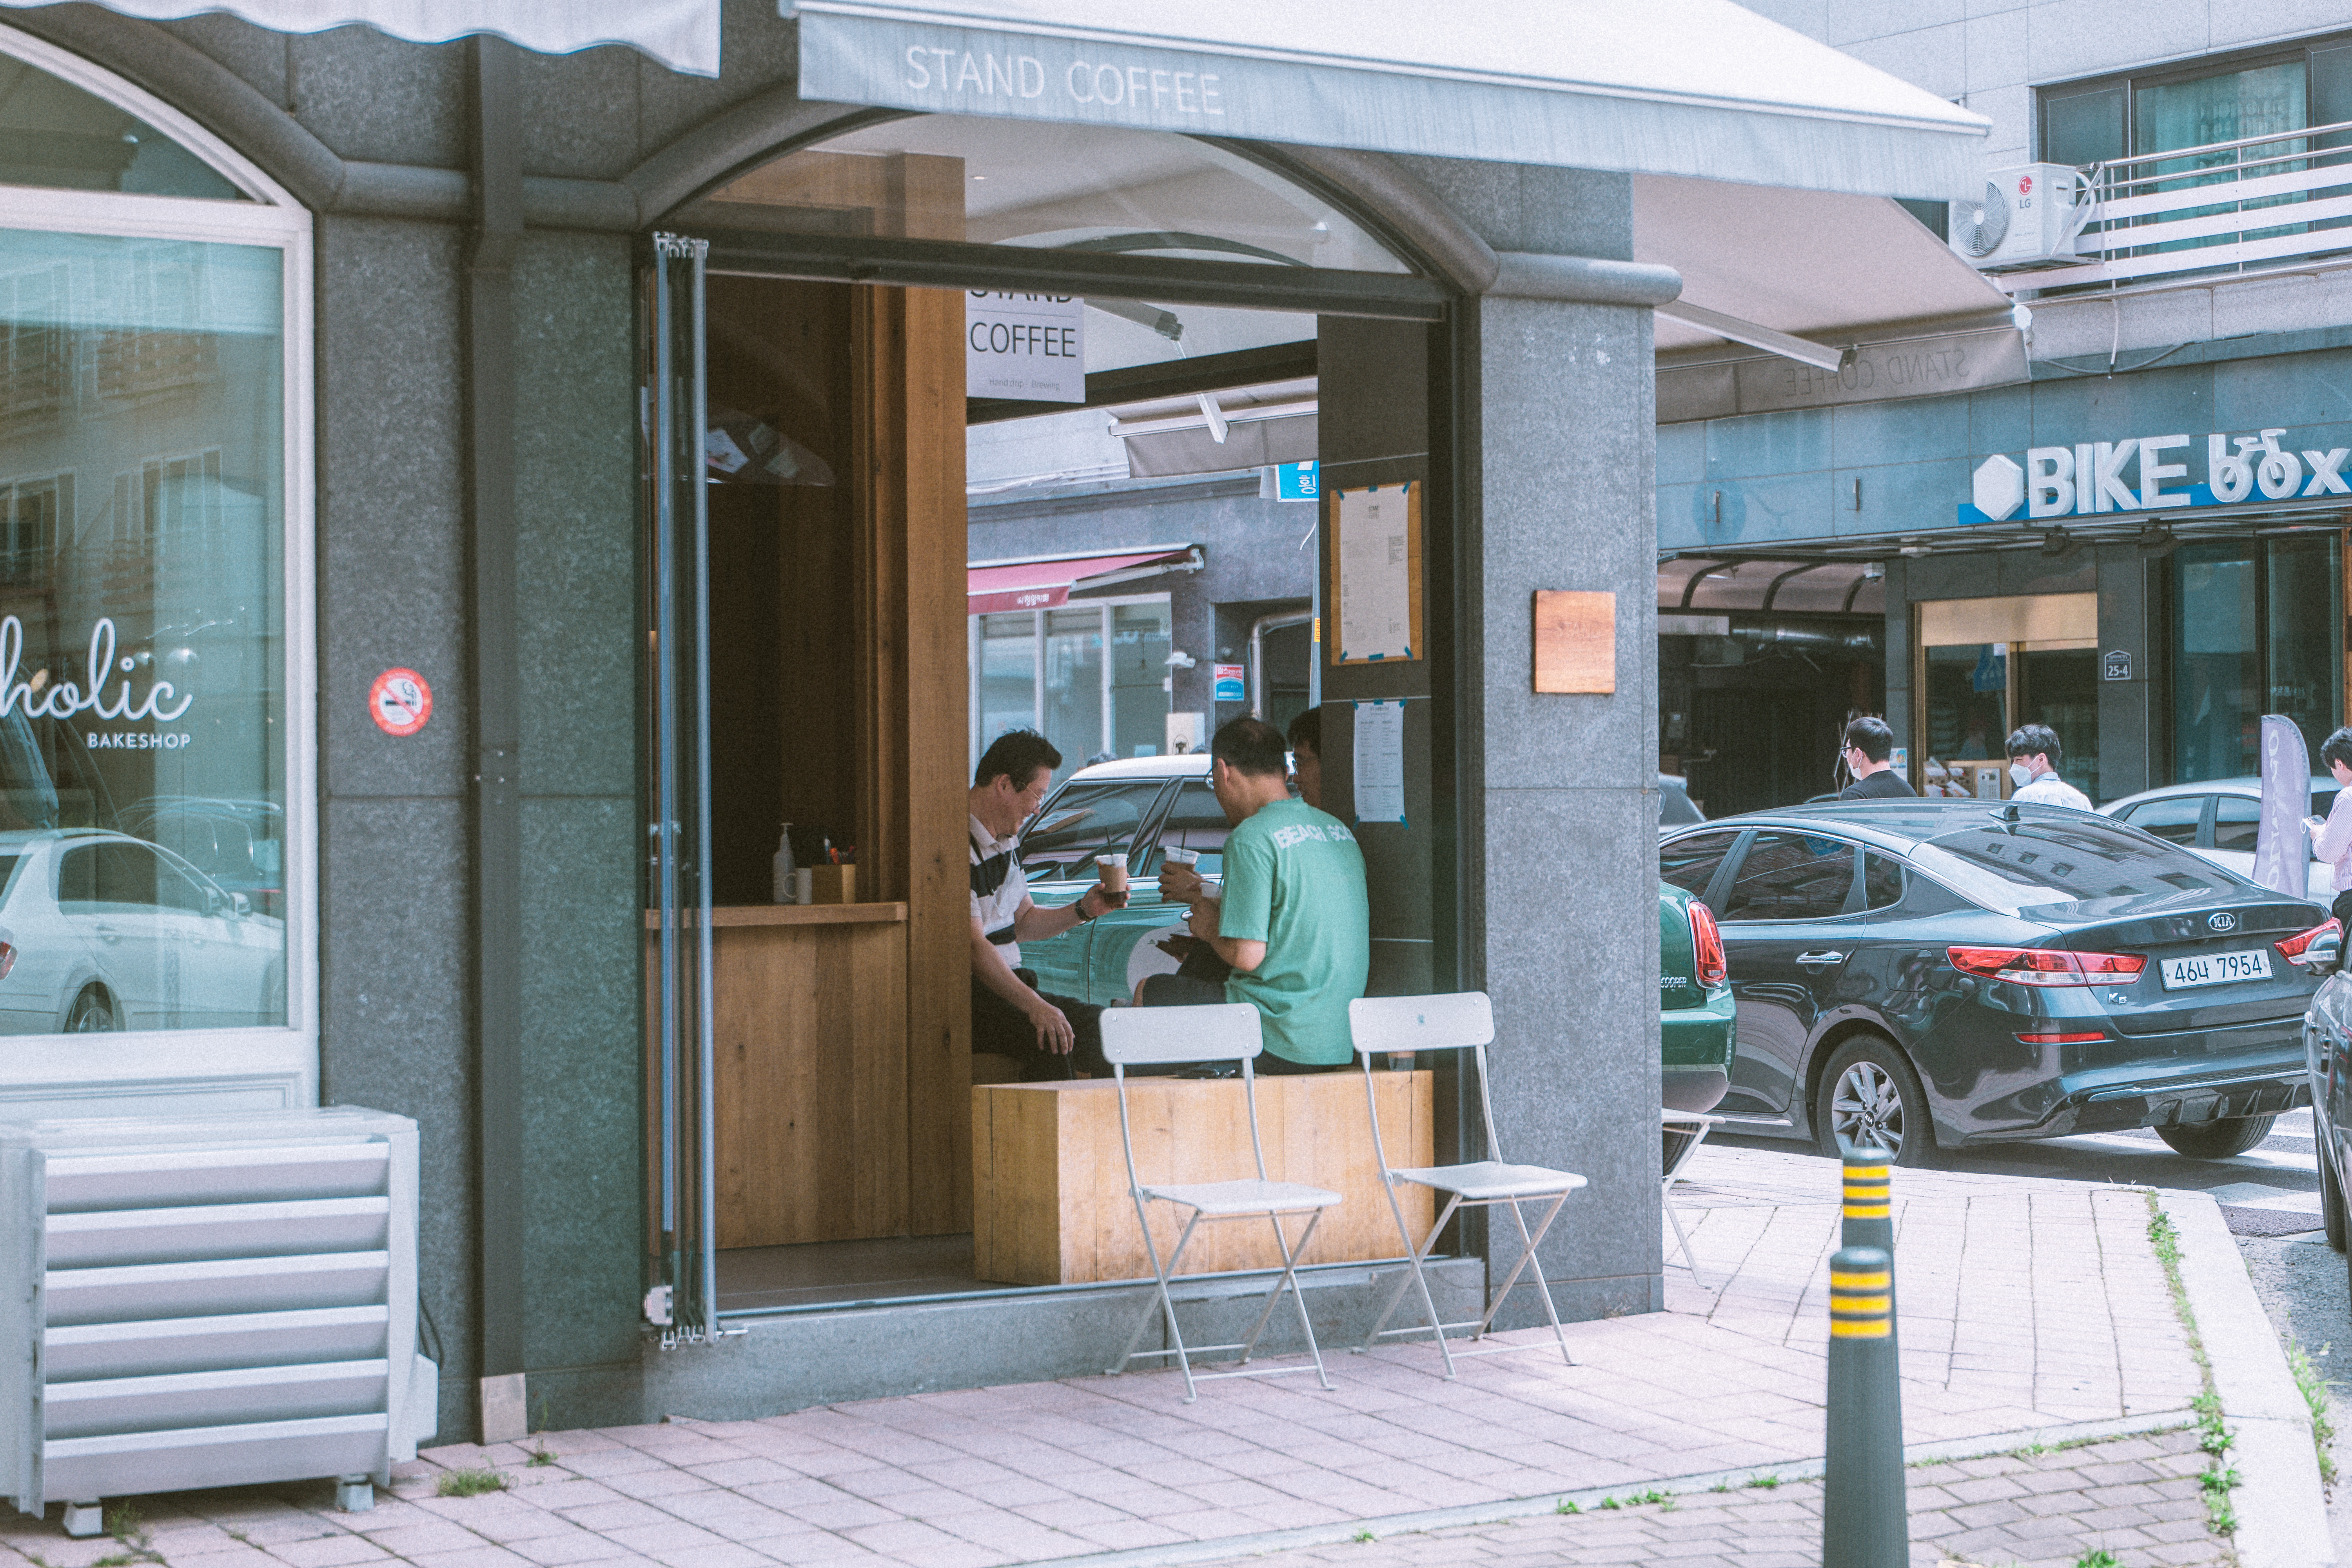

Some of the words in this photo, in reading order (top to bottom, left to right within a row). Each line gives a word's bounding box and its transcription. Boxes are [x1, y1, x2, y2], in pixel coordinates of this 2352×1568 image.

[906, 45, 1045, 99] STAND
[1067, 60, 1224, 116] COFFEE
[2020, 198, 2031, 209] LG
[970, 322, 1076, 358] COFFEE
[989, 378, 1008, 387] Hand
[1032, 380, 1060, 392] Brewing
[2028, 434, 2191, 518] BIKE
[2209, 428, 2351, 503] box
[2107, 665, 2129, 677] 25-4
[87, 732, 191, 749] BAKESHOP
[1274, 824, 1328, 849] BEACH
[2213, 916, 2232, 928] KIA
[2174, 960, 2209, 983] 46나
[2216, 954, 2262, 978] 7954
[2108, 993, 2127, 1005] K5
